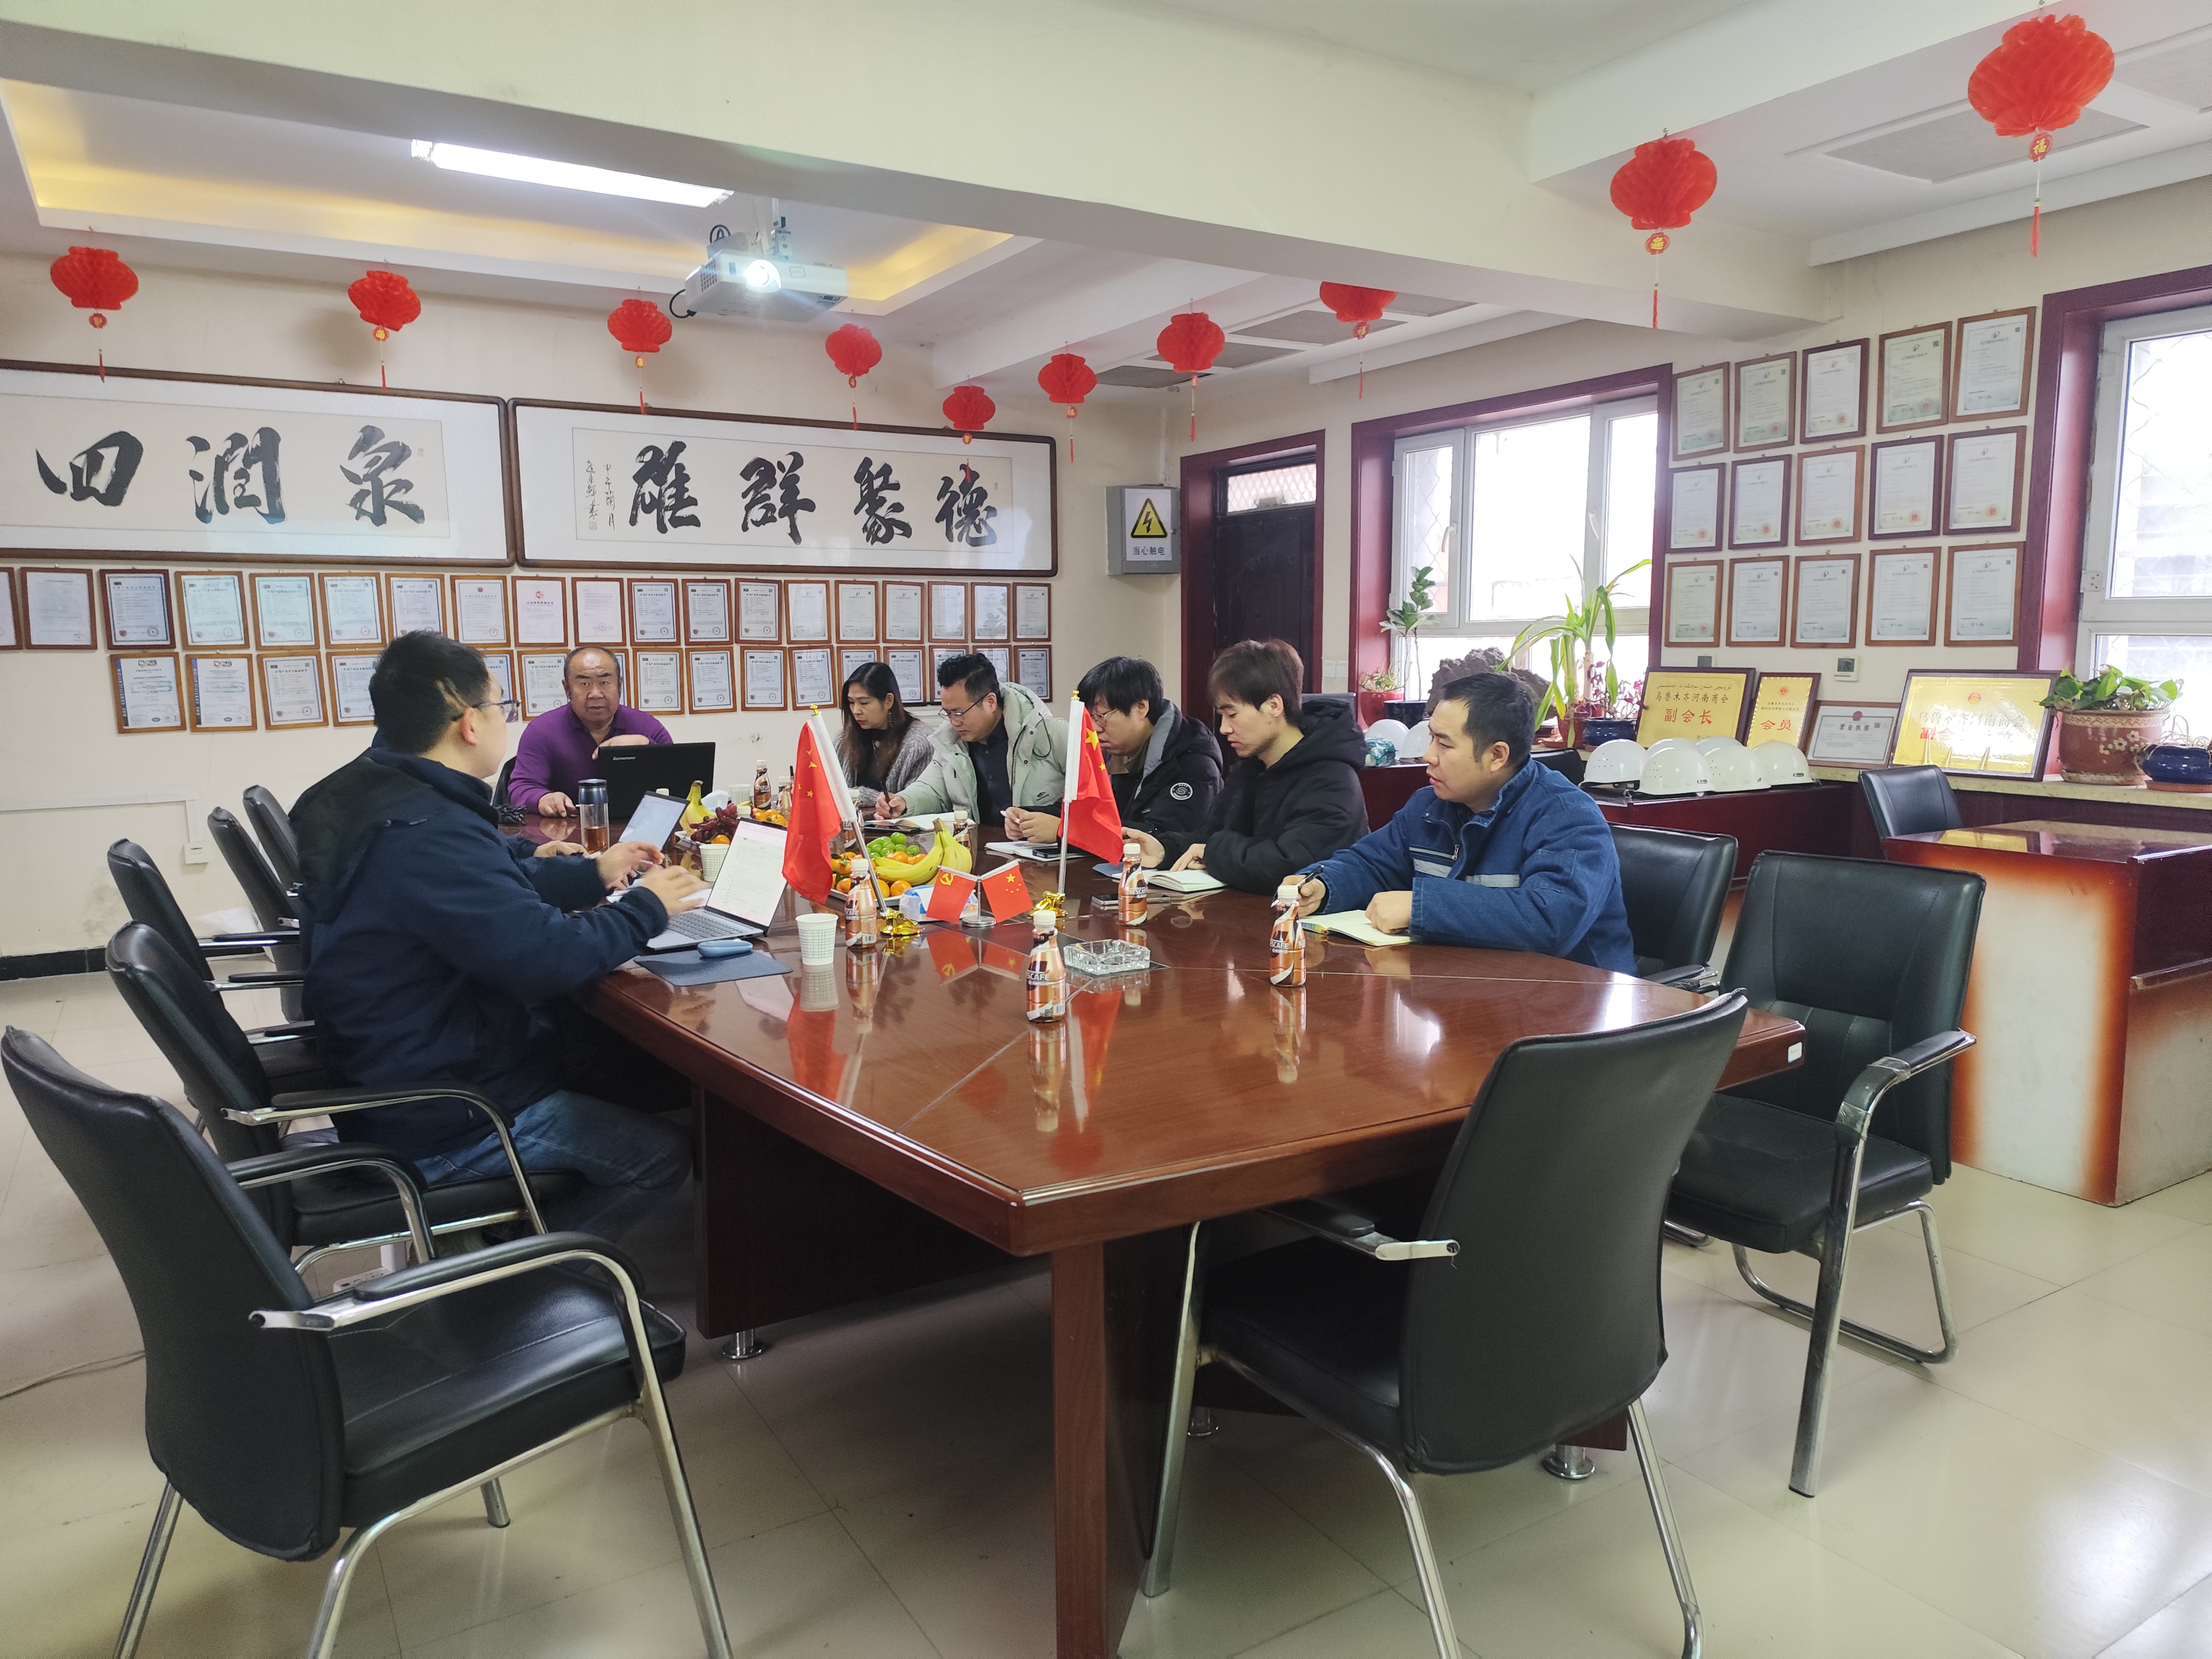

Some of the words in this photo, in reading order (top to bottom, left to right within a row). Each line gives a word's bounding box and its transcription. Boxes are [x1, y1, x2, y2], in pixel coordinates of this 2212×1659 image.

[2033, 138, 2047, 155] 福
[1133, 545, 1166, 556] 当心触电
[1656, 691, 1728, 703] 乌鲁木齐河南商会
[1664, 709, 1712, 724] 副会长
[1761, 719, 1792, 731] 会员
